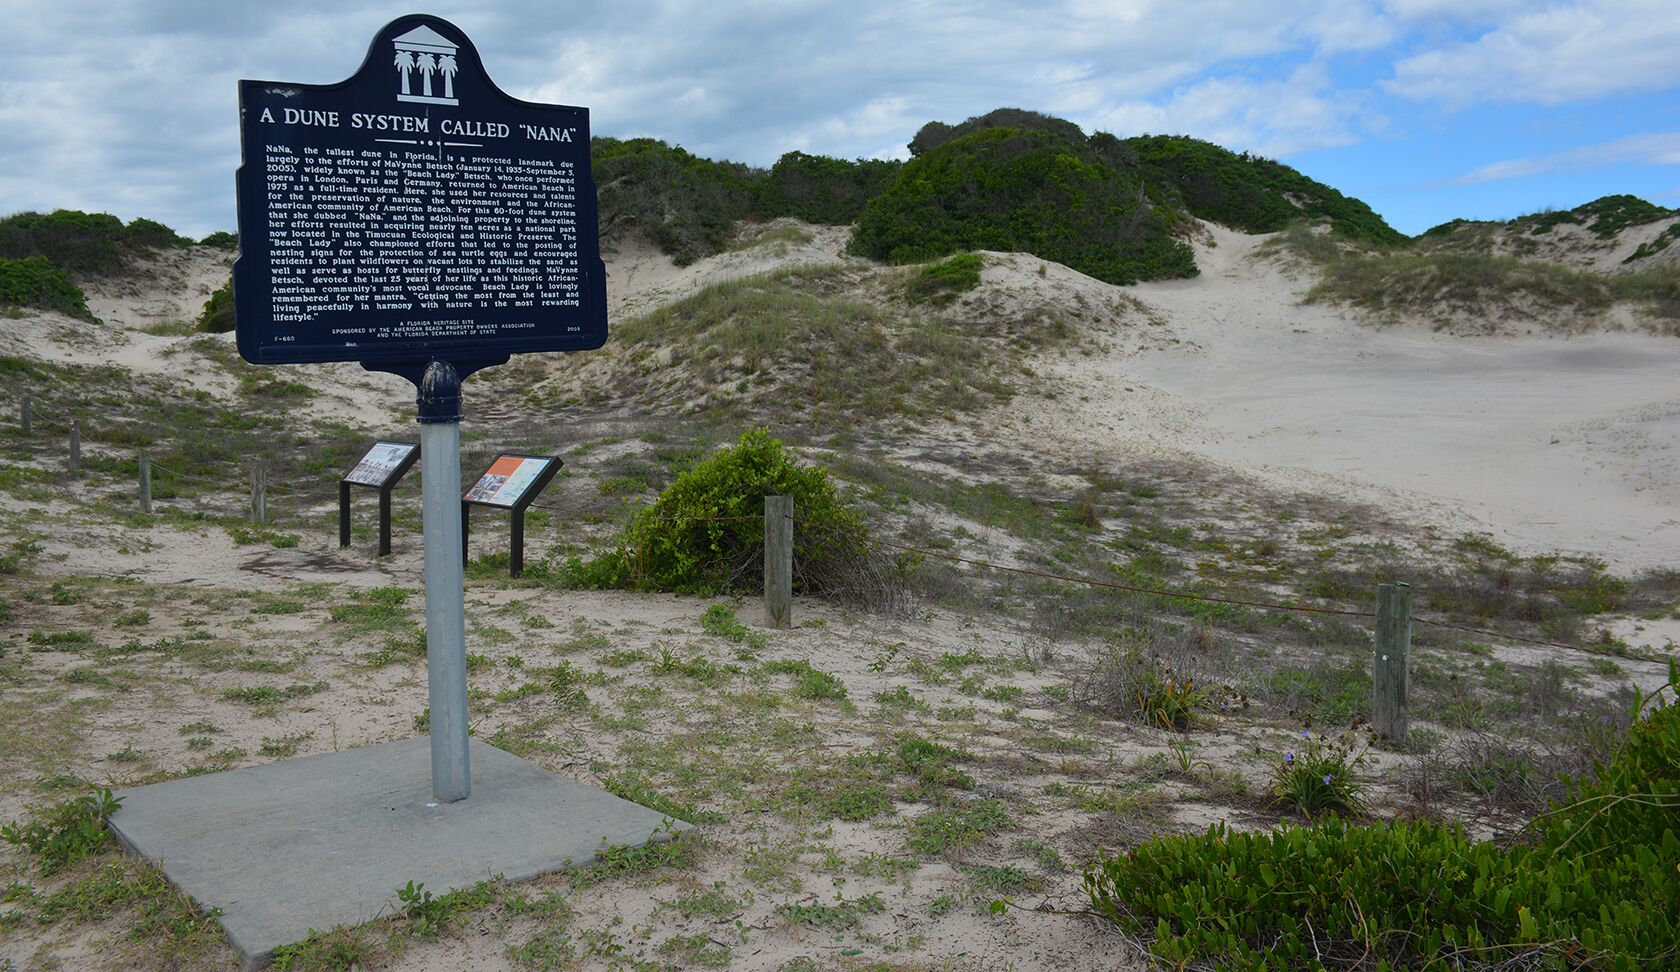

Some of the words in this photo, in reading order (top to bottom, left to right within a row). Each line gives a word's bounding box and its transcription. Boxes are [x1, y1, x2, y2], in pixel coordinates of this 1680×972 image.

[260, 107, 275, 123] A
[284, 108, 340, 127] DUNE
[351, 113, 430, 133] SYSTEM
[440, 120, 510, 138] CALLED
[266, 145, 293, 154] NaNa,
[325, 148, 354, 156] tallest
[361, 150, 382, 158] dune
[405, 152, 438, 161] Florida,
[472, 156, 511, 165] protected
[518, 158, 554, 167] landmark
[266, 164, 297, 173] 2005),
[303, 166, 333, 176] widely
[337, 167, 365, 175] known
[463, 172, 492, 181] Betsch,
[536, 176, 574, 184] performed
[266, 175, 294, 184] opera
[315, 175, 349, 184] London,
[403, 179, 443, 188] Germany,
[501, 182, 538, 190] American
[267, 192, 282, 200] for
[311, 194, 370, 202] preservation
[376, 195, 386, 203] of
[392, 196, 422, 204] nature,
[450, 198, 500, 206] environment
[543, 200, 575, 208] African-
[268, 201, 313, 209] American
[317, 203, 364, 212] community
[383, 204, 423, 212] American
[427, 205, 453, 213] Beach.
[493, 207, 524, 215] 60-foot
[268, 220, 285, 228] her
[329, 221, 366, 229] resulted
[383, 222, 424, 232] acquiring
[429, 223, 456, 231] nearly
[291, 230, 326, 238] located
[331, 230, 340, 238] in
[345, 230, 360, 238] the
[411, 231, 454, 240] Ecological
[479, 232, 512, 240] Historic
[562, 233, 576, 241] The
[344, 239, 362, 247] also
[369, 240, 419, 248] championed
[425, 240, 455, 248] efforts
[534, 241, 562, 250] posting
[270, 248, 304, 258] nesting
[310, 248, 334, 258] signs
[339, 248, 353, 256] for
[379, 249, 424, 257] protection
[533, 250, 577, 258] encouraged
[270, 257, 313, 265] residents
[332, 257, 355, 266] plant
[359, 257, 409, 265] wildflowers
[271, 285, 316, 293] American
[322, 284, 376, 293] community's
[510, 283, 529, 291] Lady
[548, 282, 578, 291] lovingly
[272, 304, 300, 313] living
[306, 303, 354, 312] peacefully
[361, 302, 370, 310] in
[376, 302, 413, 310] harmony
[541, 299, 579, 307] rewarding
